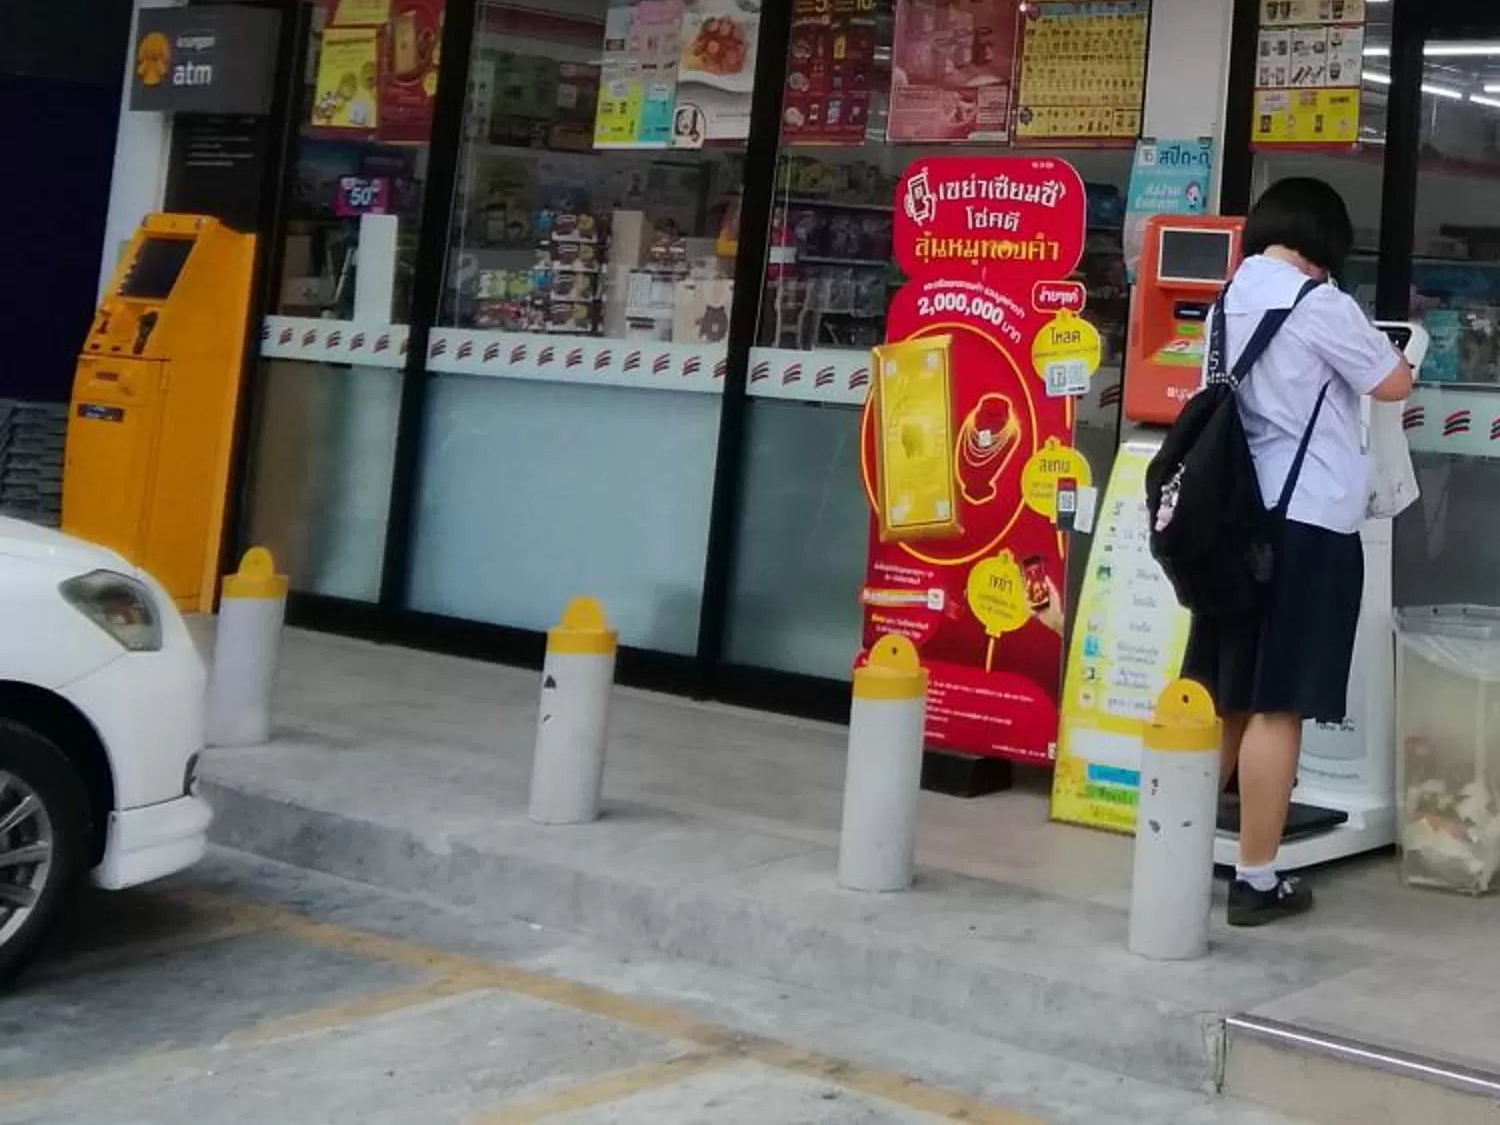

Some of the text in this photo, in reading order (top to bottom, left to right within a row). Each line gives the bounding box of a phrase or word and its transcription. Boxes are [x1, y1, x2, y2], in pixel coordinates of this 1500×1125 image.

[173, 61, 212, 85] atm
[965, 206, 1020, 232] โชคดี
[917, 292, 1005, 325] 2,000,000
